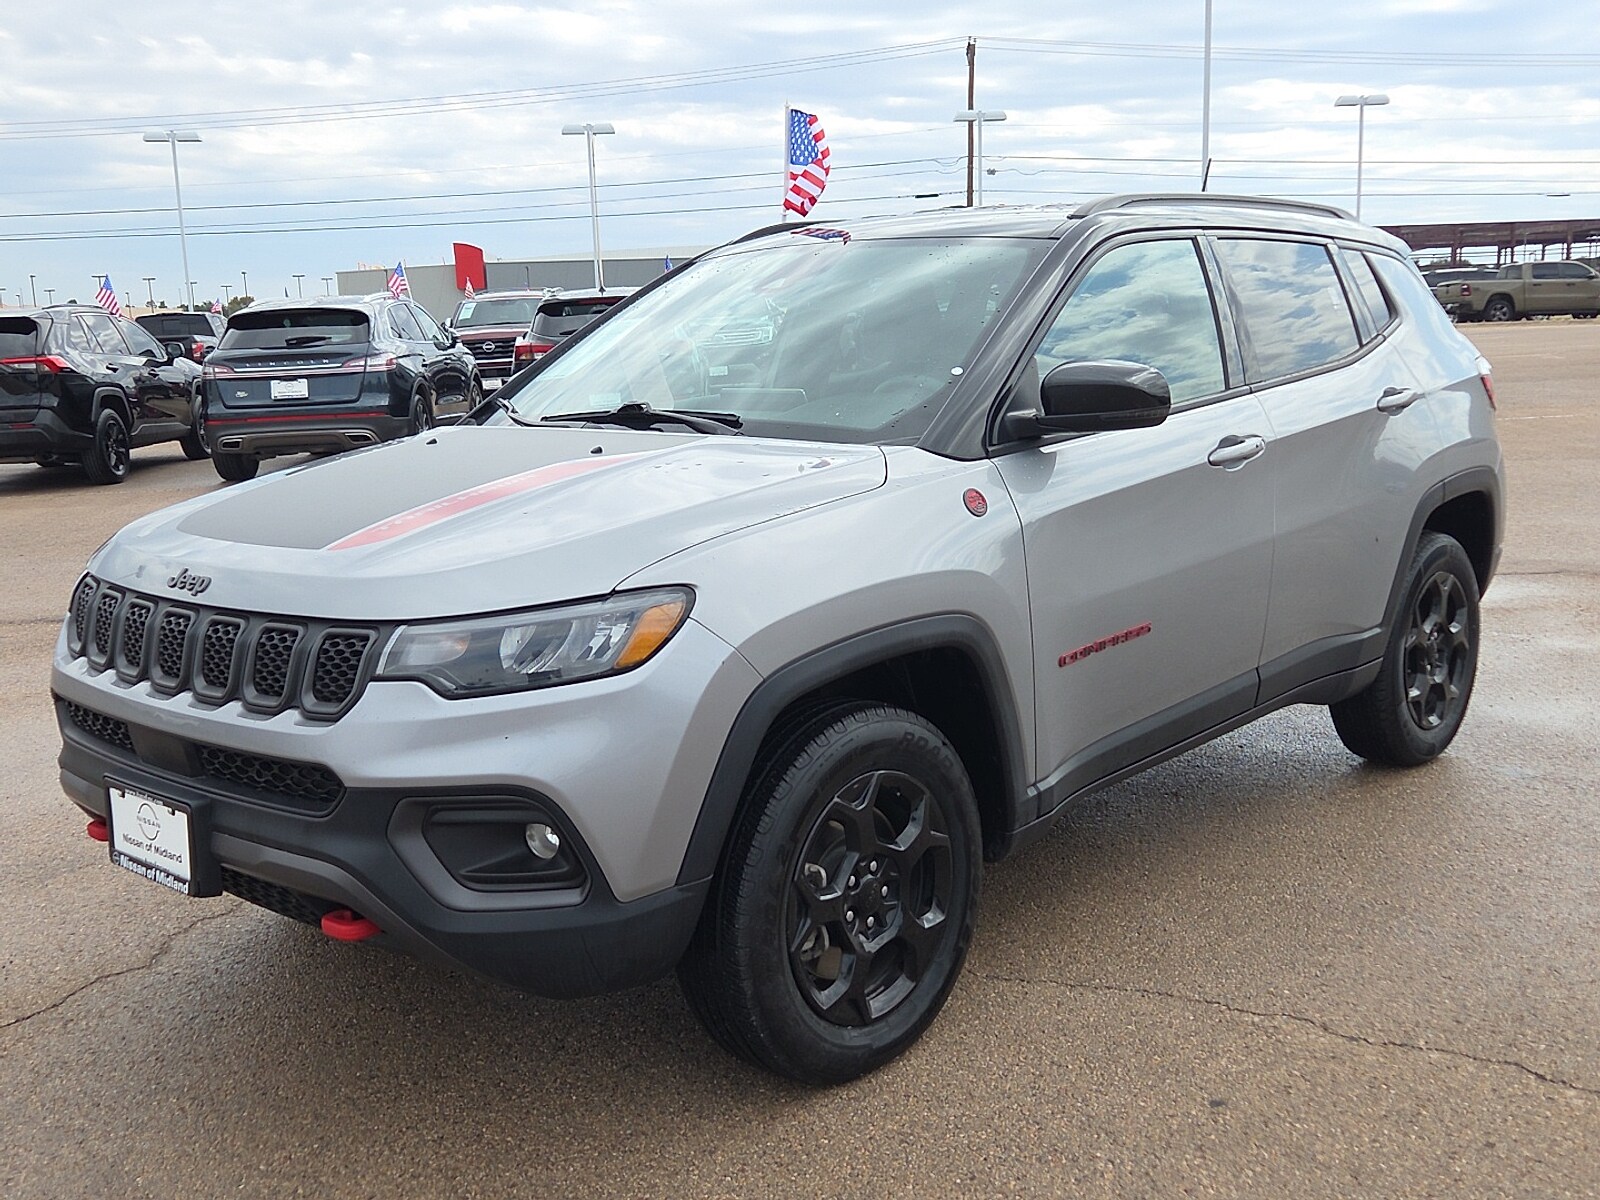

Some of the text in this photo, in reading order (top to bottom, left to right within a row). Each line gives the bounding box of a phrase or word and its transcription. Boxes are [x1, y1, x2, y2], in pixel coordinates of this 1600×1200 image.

[245, 359, 329, 367] LINCOLN
[166, 567, 212, 597] Jeep
[1057, 621, 1152, 668] COMPASS
[137, 815, 161, 829] NISSAN
[122, 832, 183, 864] Nissan of Midland
[120, 854, 146, 878] Nissan
[146, 867, 156, 879] of
[156, 869, 189, 895] Midland
